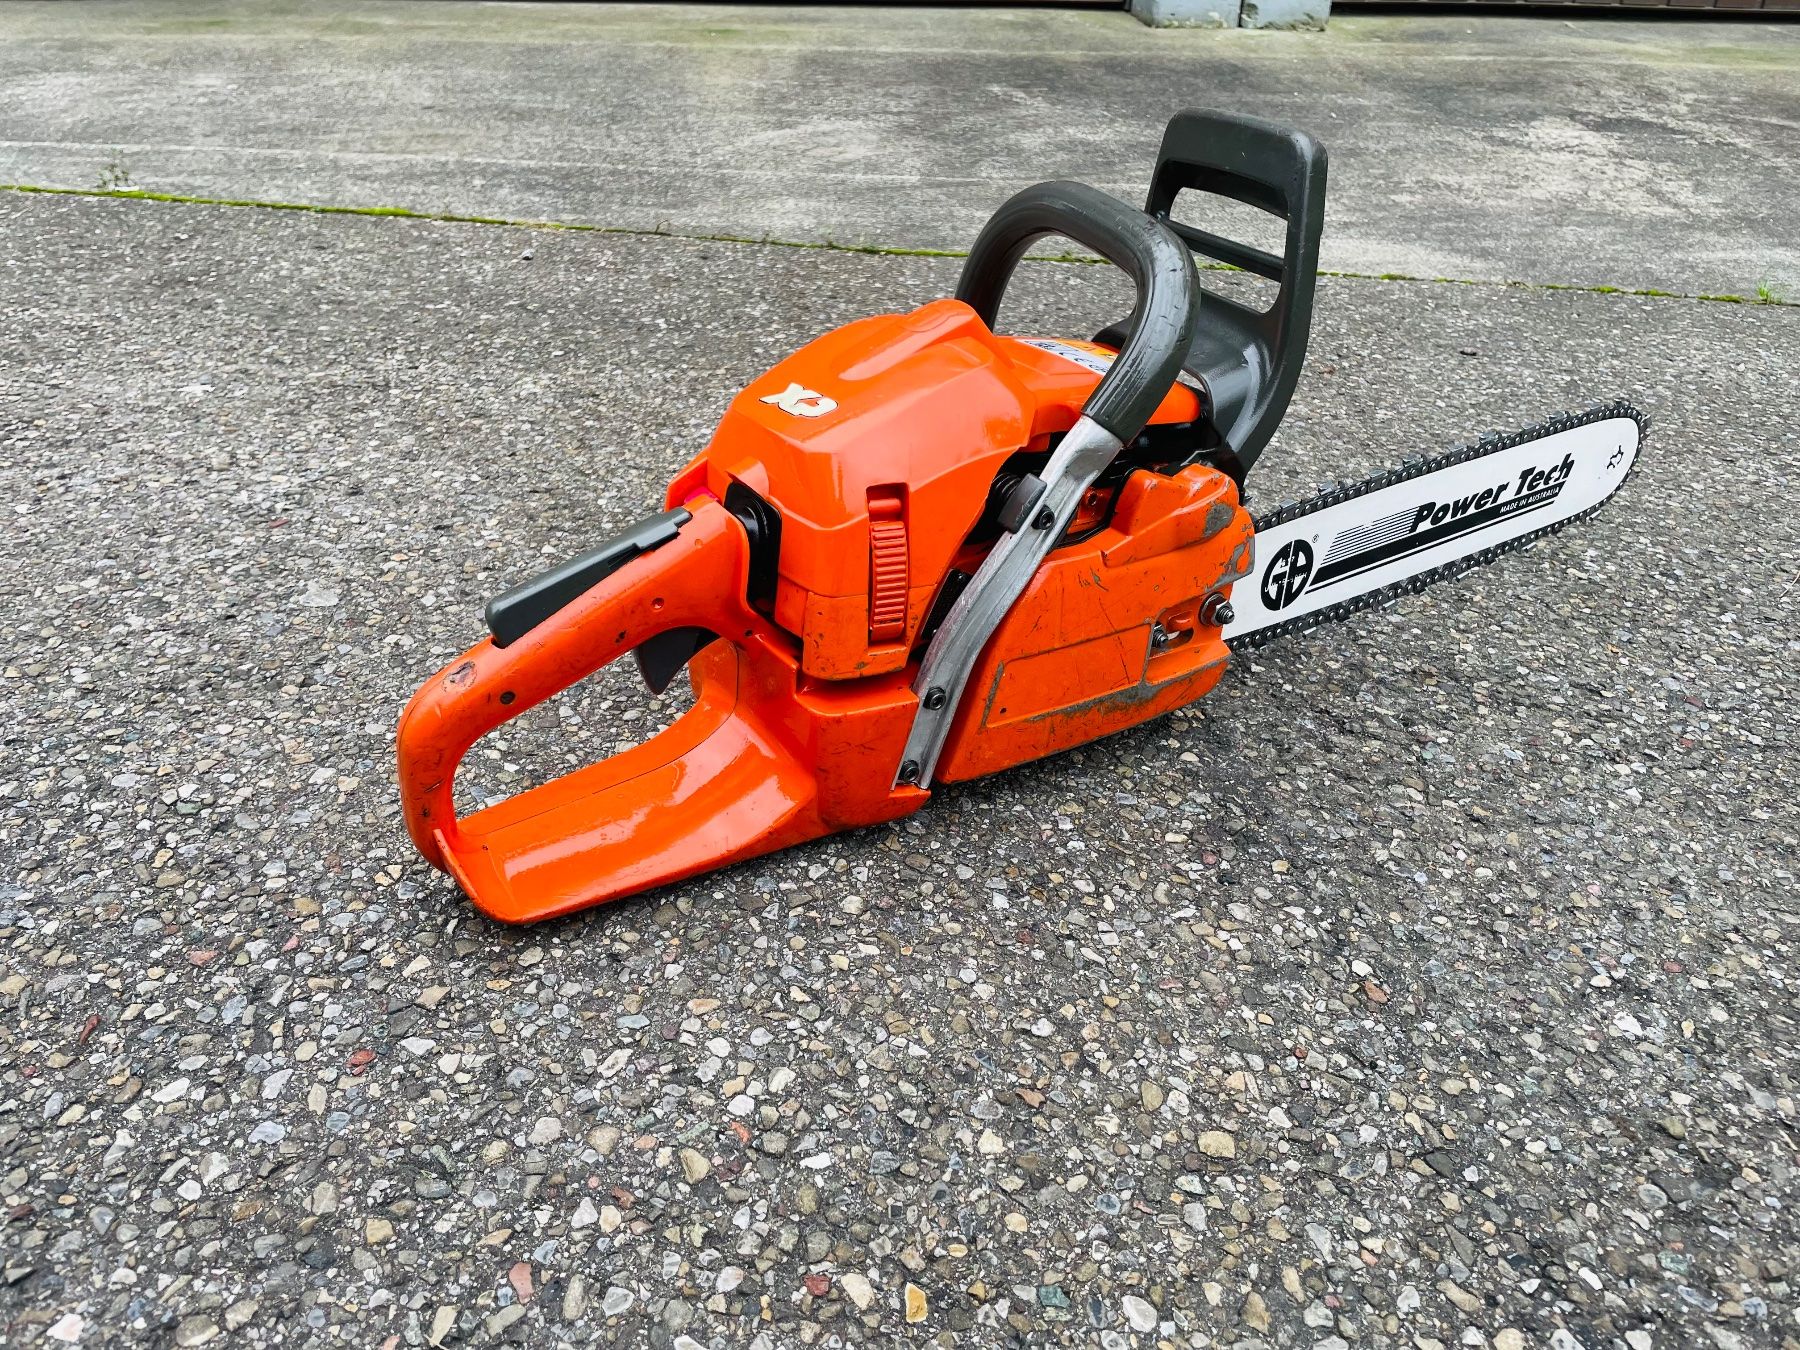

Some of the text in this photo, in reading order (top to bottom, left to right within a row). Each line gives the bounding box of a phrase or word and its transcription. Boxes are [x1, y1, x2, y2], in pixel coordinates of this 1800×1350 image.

[1409, 453, 1575, 533] Power Tech
[1499, 486, 1560, 514] MADE IN AUSTRALIA
[1261, 539, 1314, 611] GB
